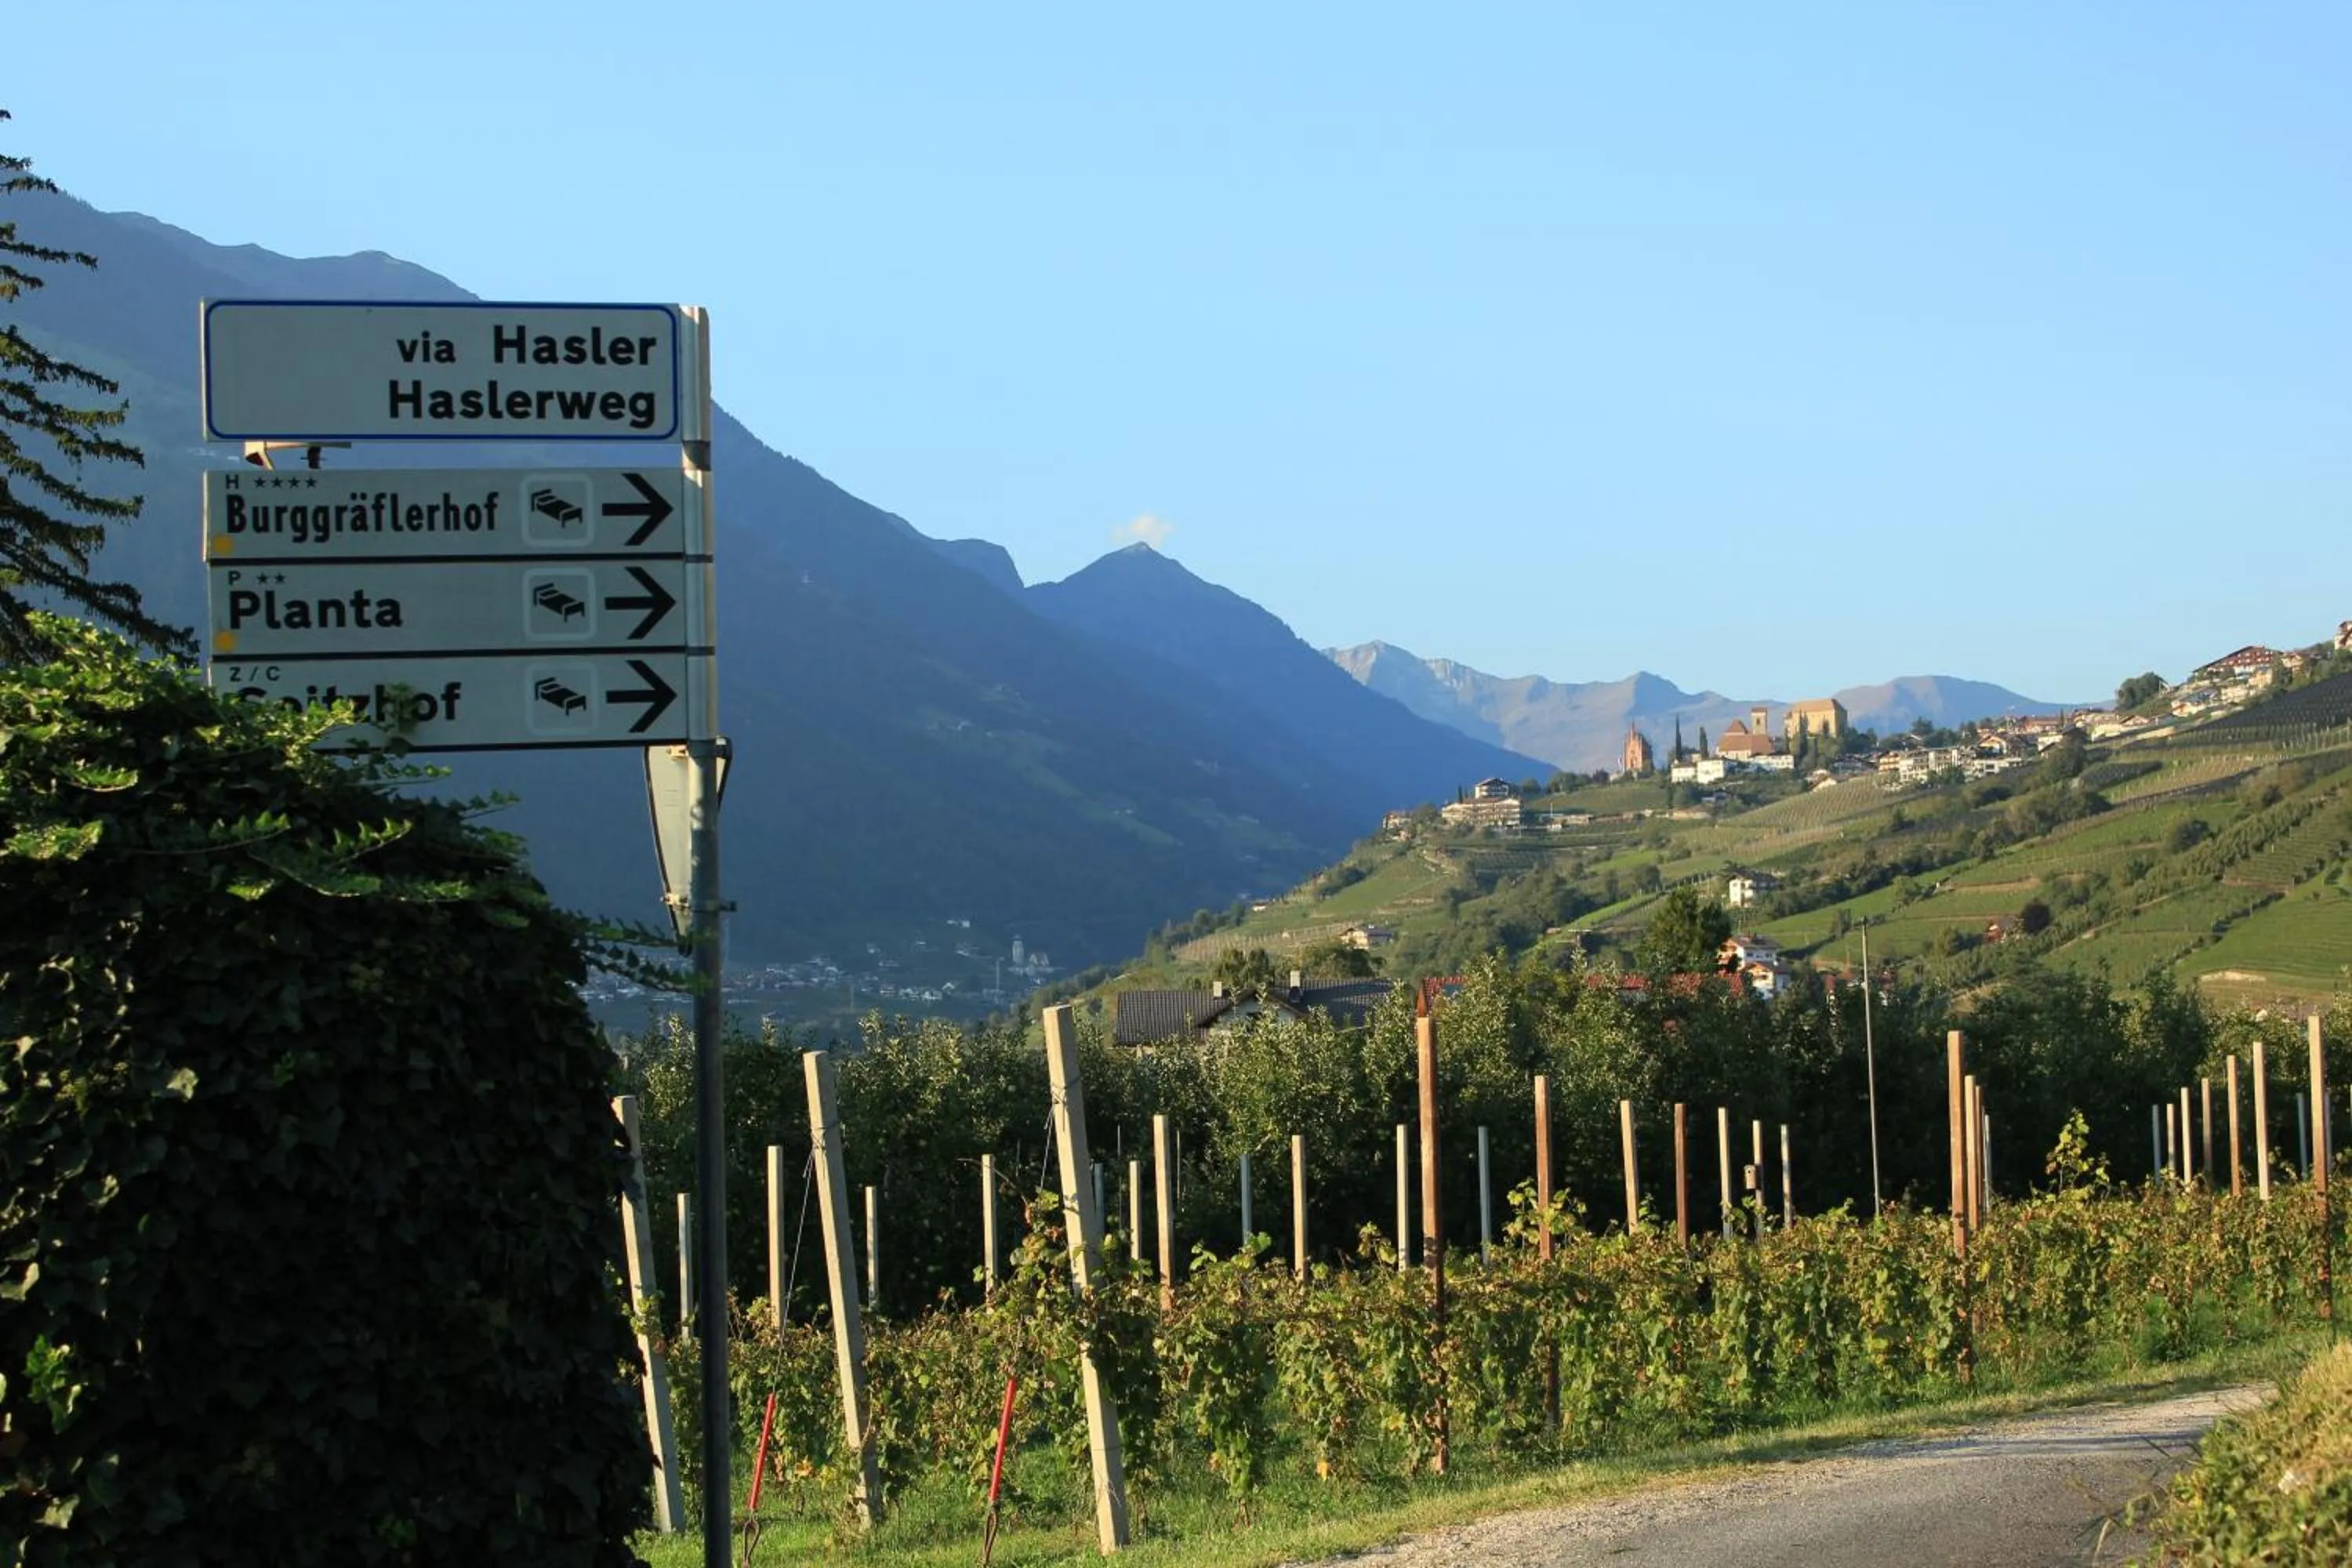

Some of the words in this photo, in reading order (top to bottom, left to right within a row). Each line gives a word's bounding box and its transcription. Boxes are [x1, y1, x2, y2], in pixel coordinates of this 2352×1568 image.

[396, 329, 457, 364] via
[492, 325, 658, 365] Hasler
[388, 379, 656, 429] Haslerweg
[225, 474, 240, 490] H
[226, 492, 499, 544] Burggräflerhof
[227, 570, 241, 586] P
[229, 589, 403, 630] Planta
